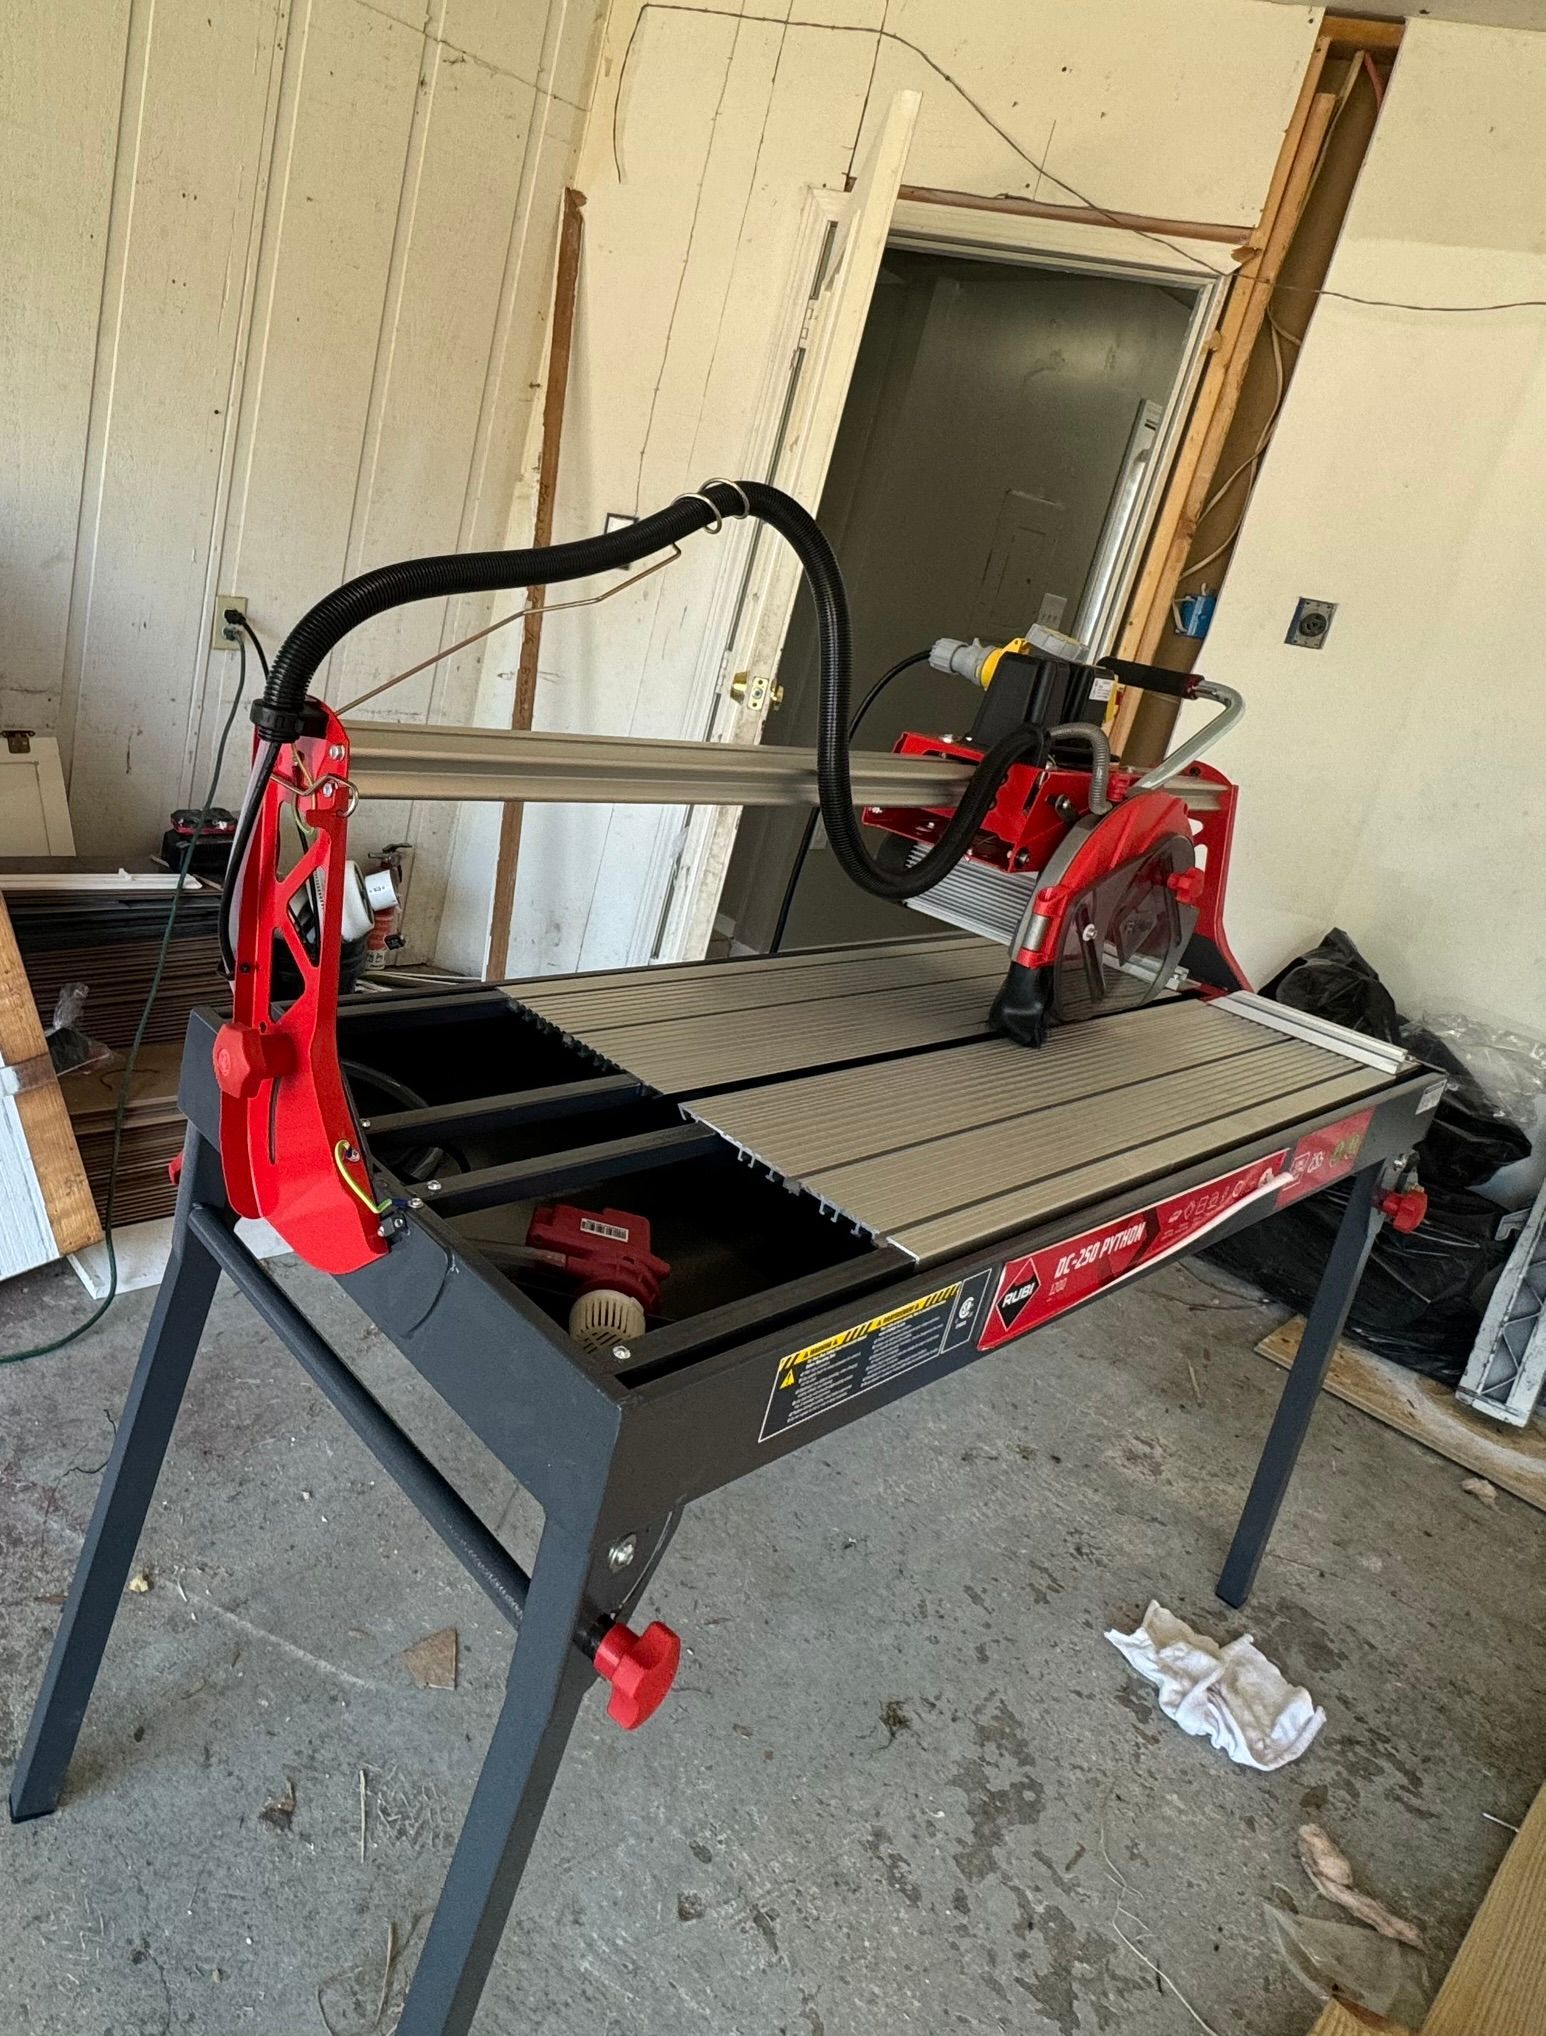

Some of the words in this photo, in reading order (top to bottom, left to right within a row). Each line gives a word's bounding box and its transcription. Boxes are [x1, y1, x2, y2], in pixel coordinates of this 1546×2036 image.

[1054, 1241, 1100, 1279] DC-250
[1099, 1222, 1147, 1259] PYTHON
[1001, 1282, 1036, 1309] RUBI
